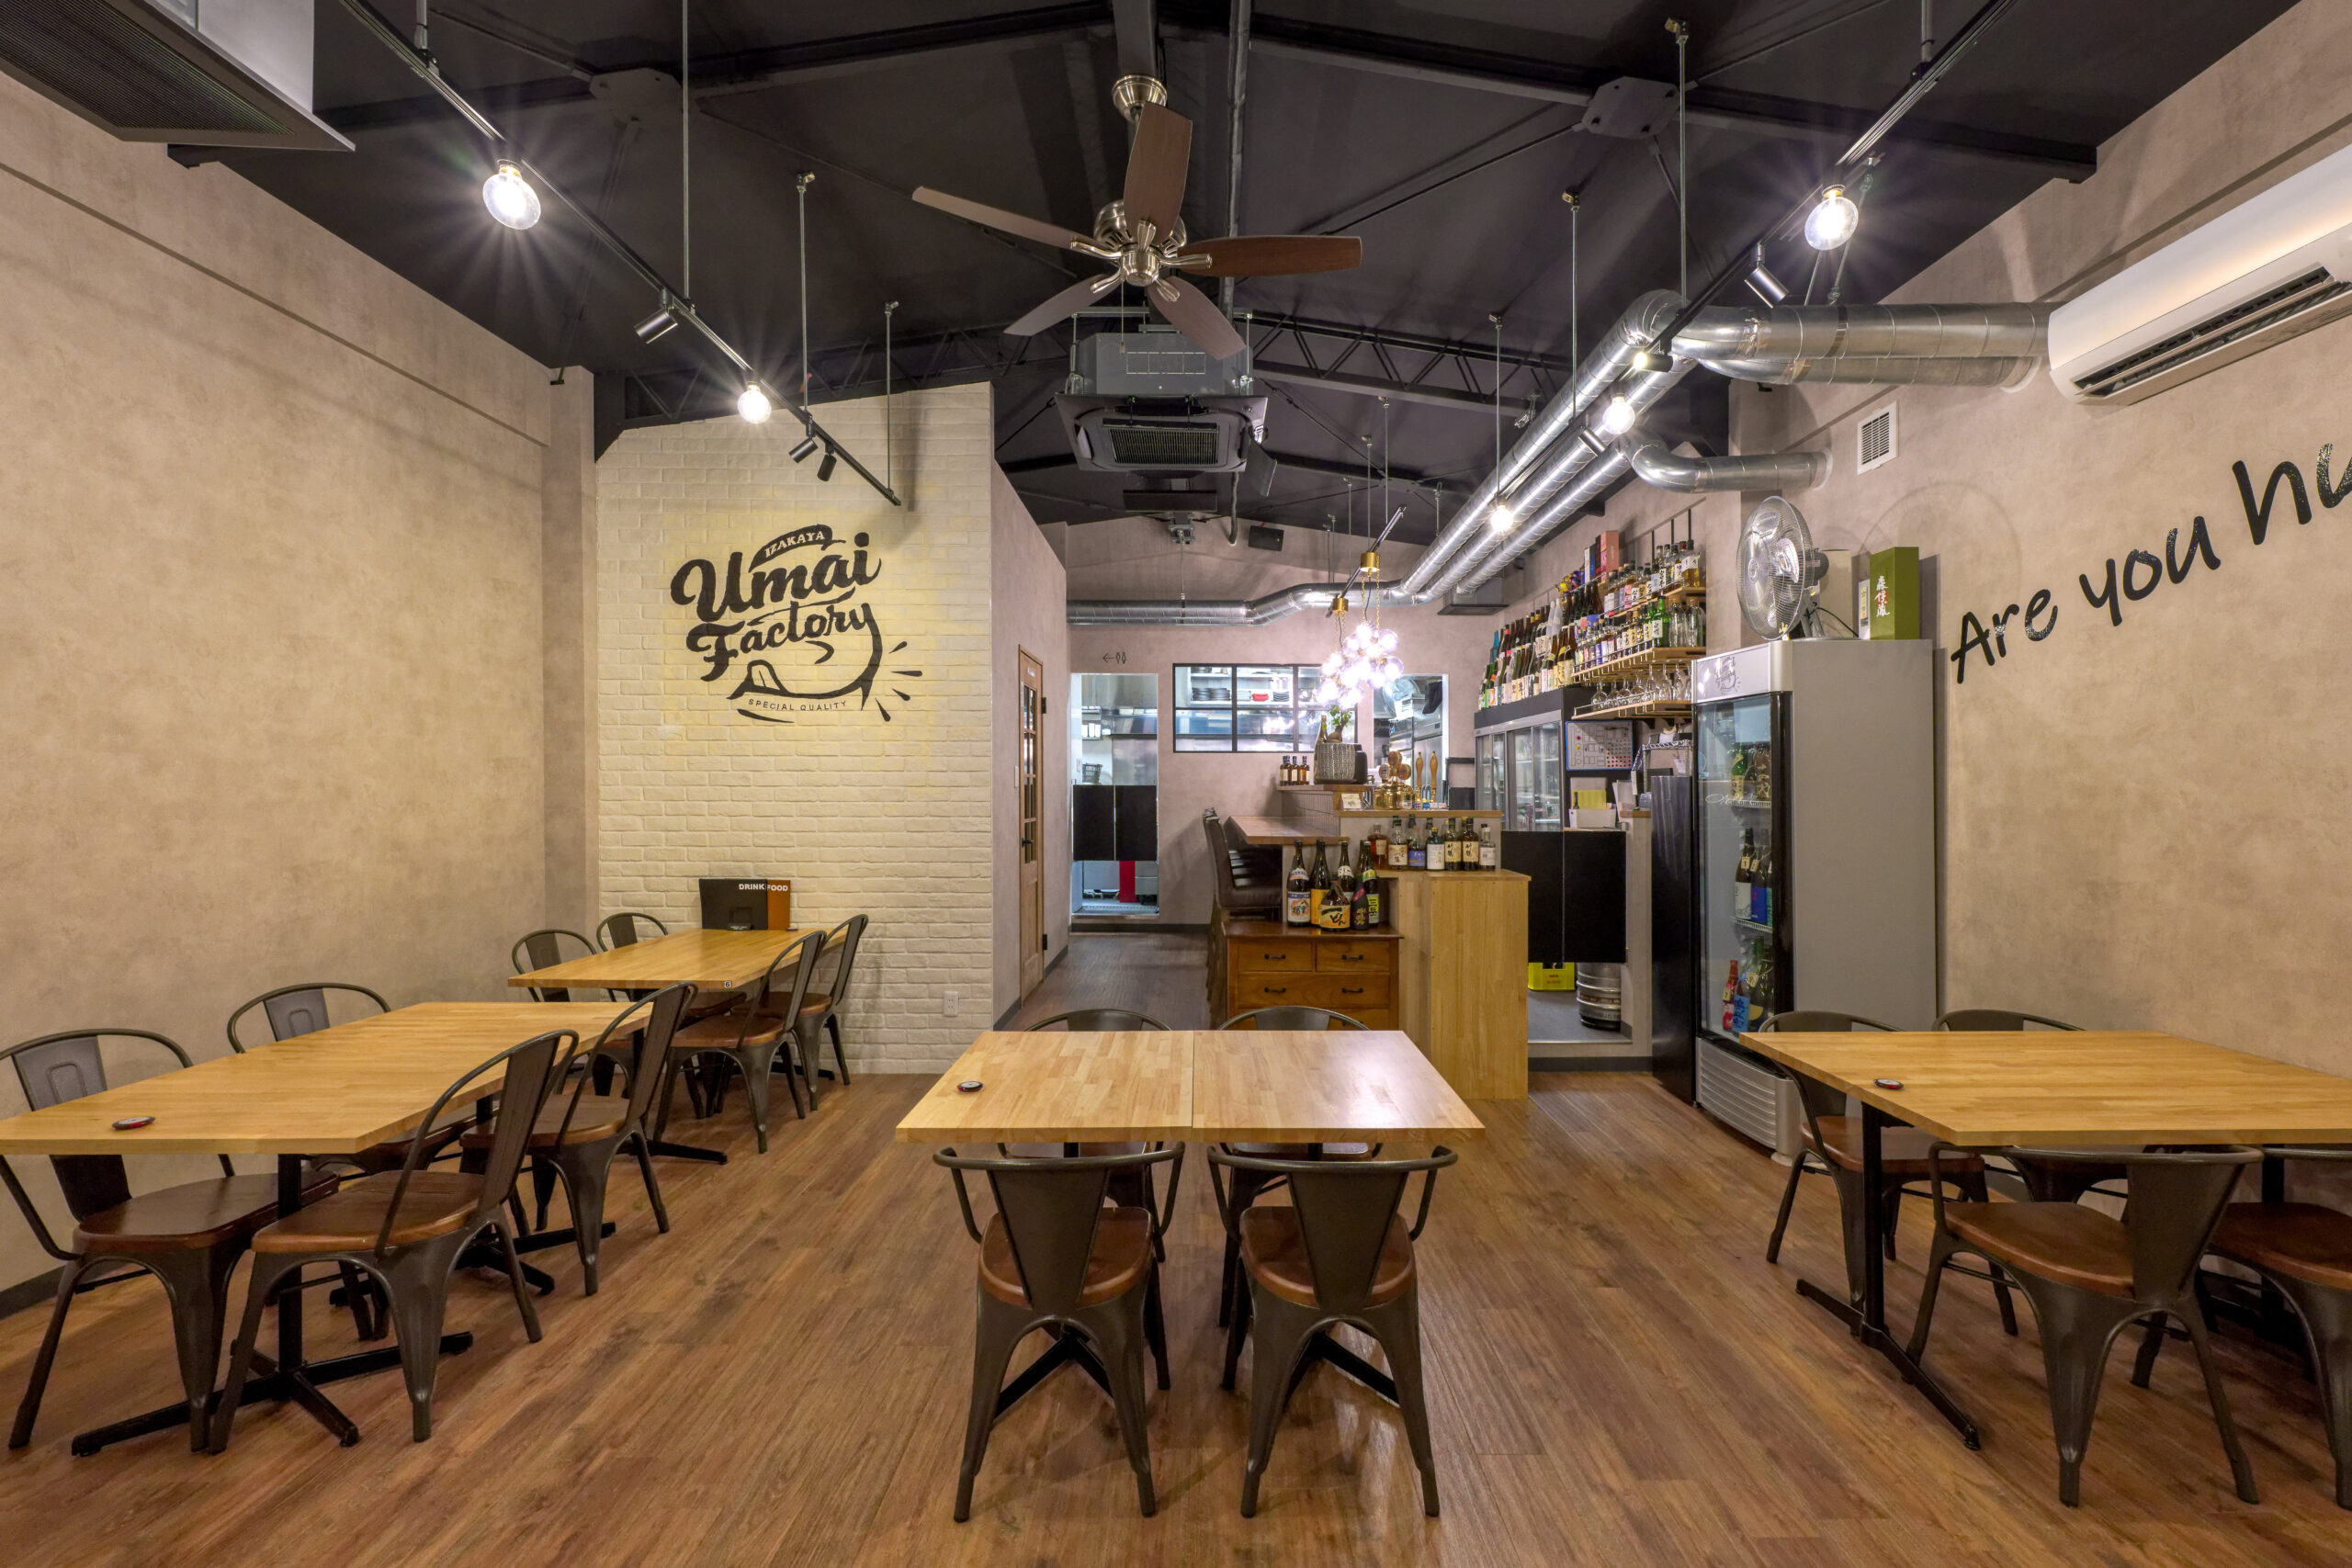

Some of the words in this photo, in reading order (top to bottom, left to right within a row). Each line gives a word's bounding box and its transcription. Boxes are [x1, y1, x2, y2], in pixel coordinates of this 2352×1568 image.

[670, 532, 882, 623] Umai
[763, 530, 826, 558] IZAKAYA
[1951, 589, 2058, 684] Are
[2078, 515, 2222, 627] you
[686, 601, 878, 682] Factory
[748, 698, 795, 711] SPECIAL
[800, 700, 847, 711] QUALITY
